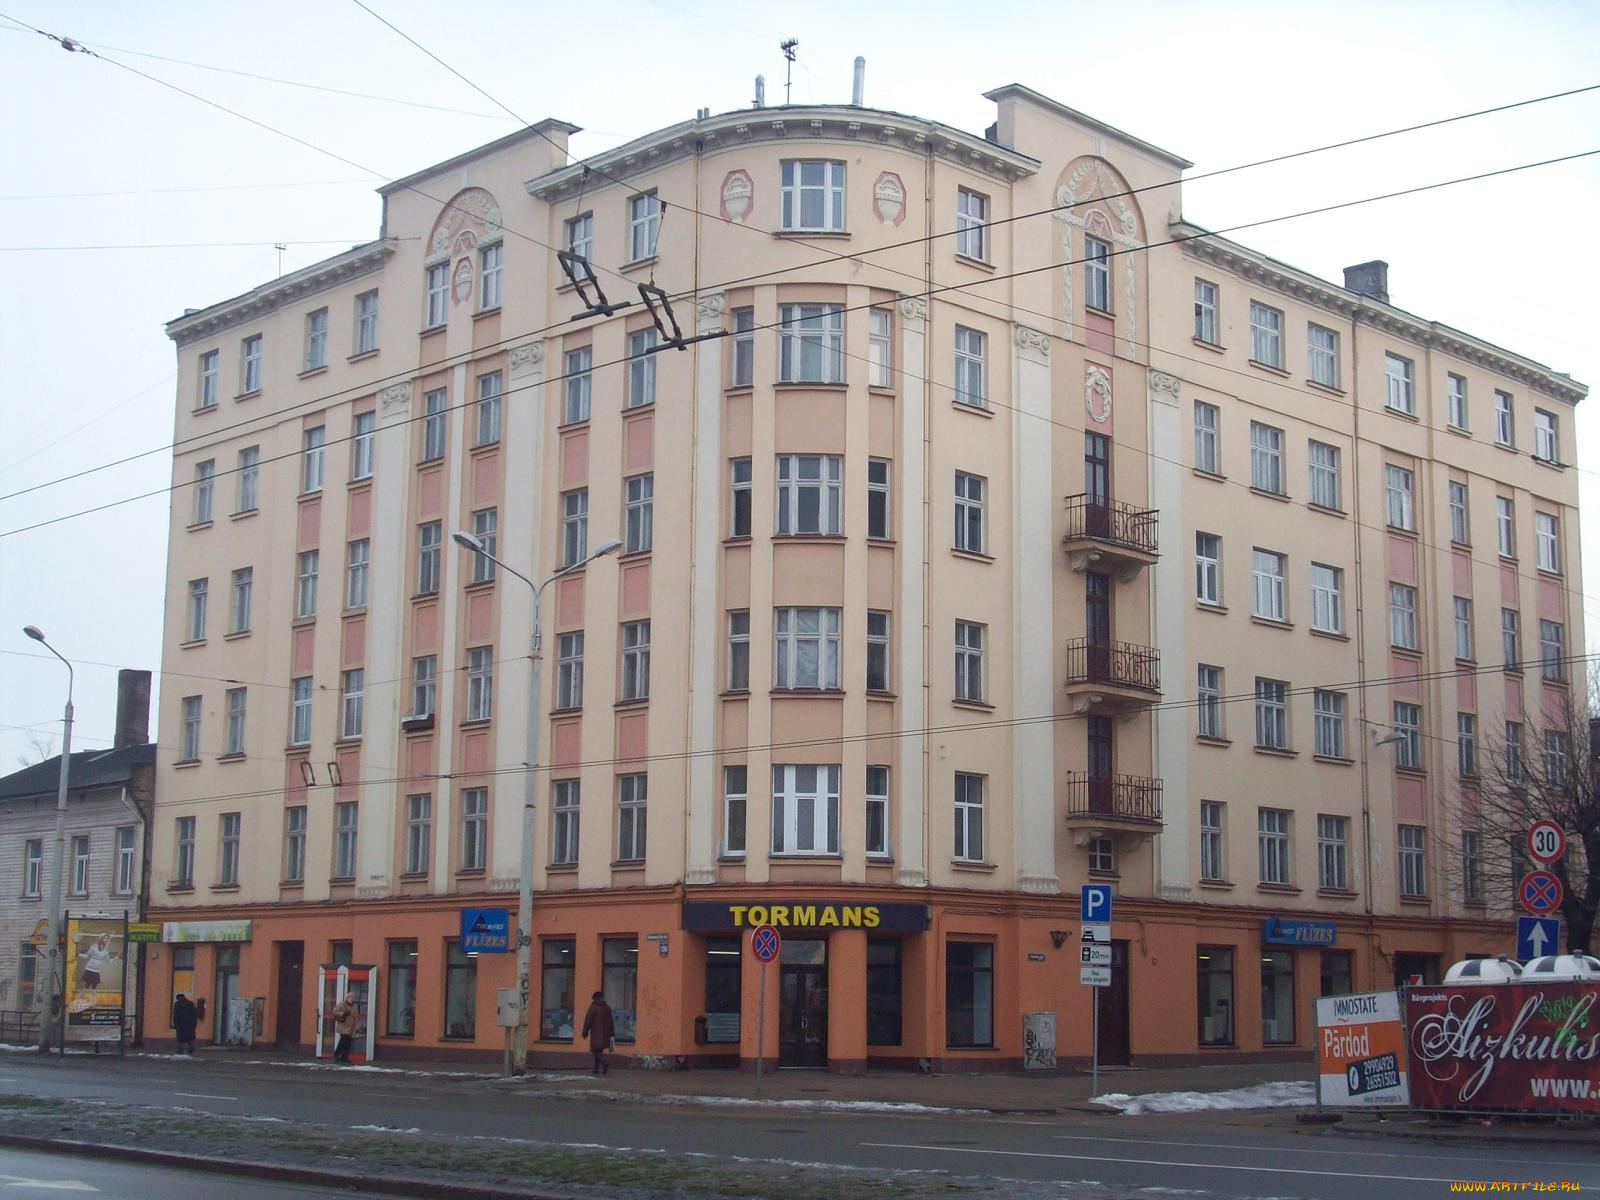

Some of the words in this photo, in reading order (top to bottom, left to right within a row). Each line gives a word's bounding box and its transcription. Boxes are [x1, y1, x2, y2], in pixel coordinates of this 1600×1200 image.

[1536, 831, 1555, 852] 30
[1088, 889, 1104, 918] P
[729, 905, 881, 928] TORMANS
[1091, 950, 1100, 960] 20
[1334, 996, 1378, 1016] IMMOSTATE
[1324, 1026, 1370, 1058] Pārdod
[1364, 1055, 1394, 1075] 29904929
[1366, 1071, 1397, 1090] 26551502
